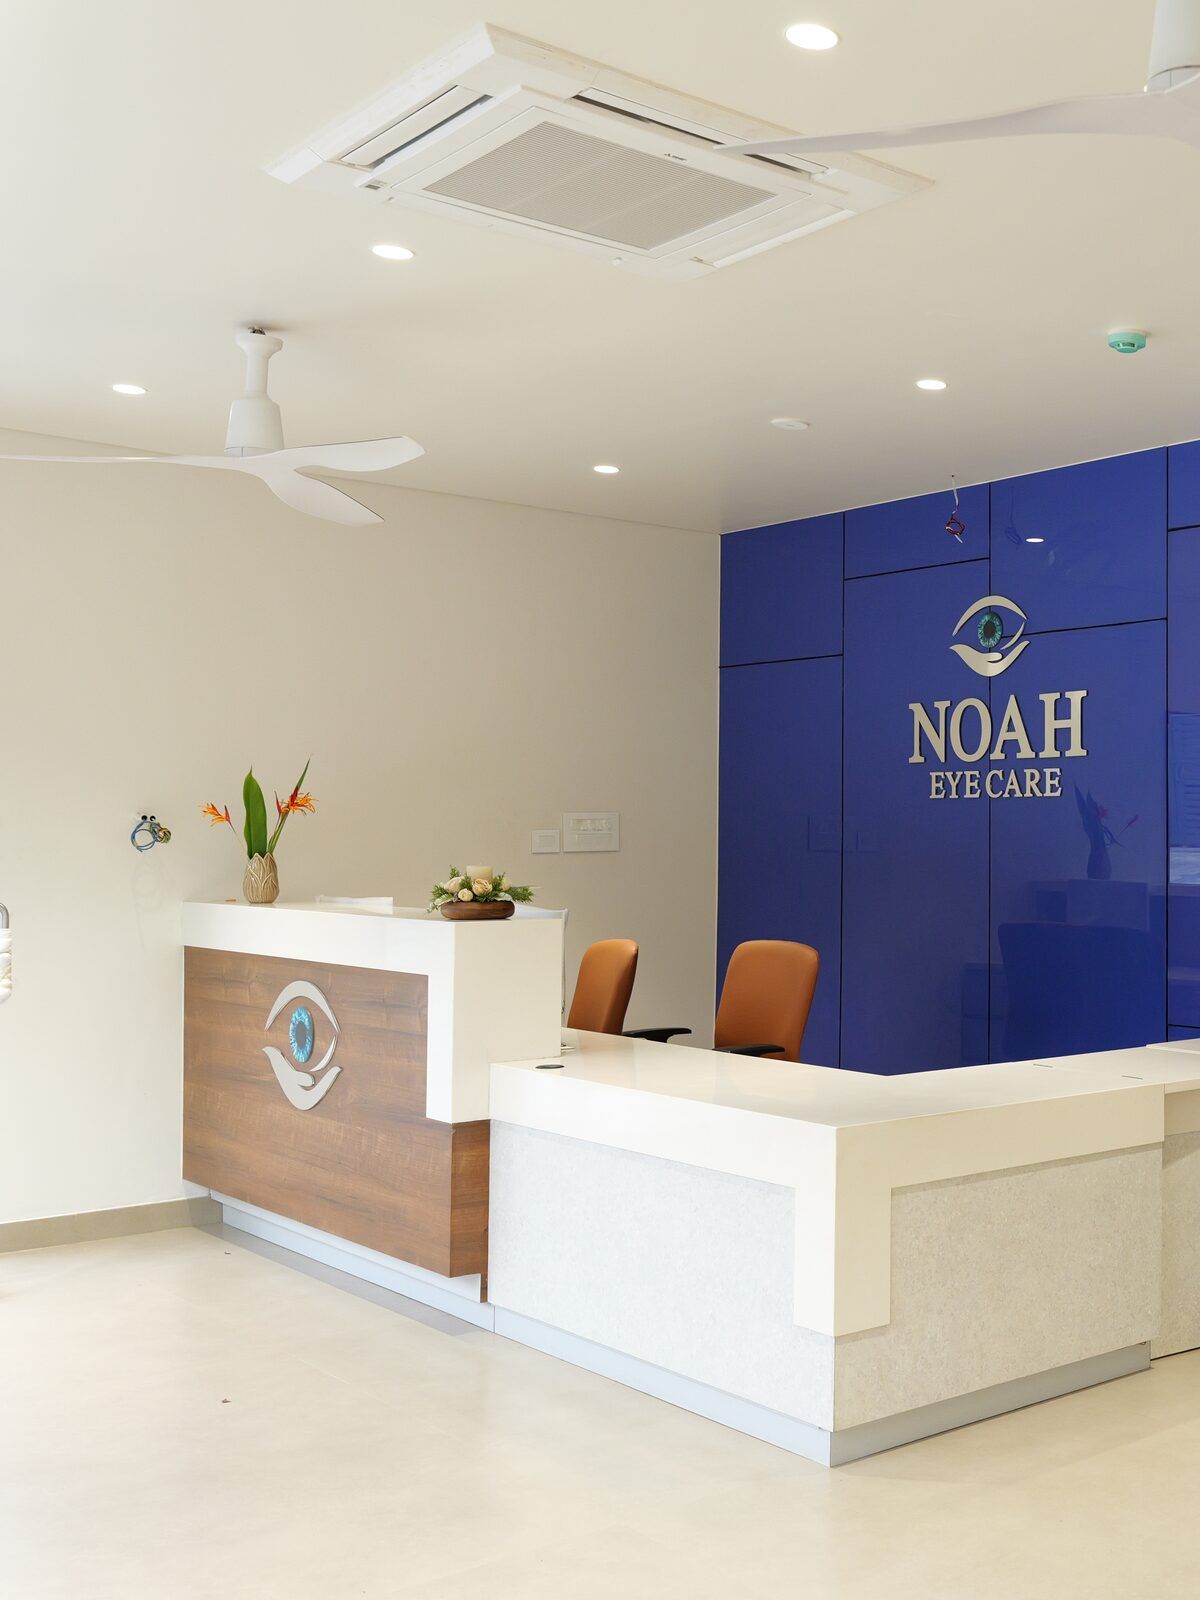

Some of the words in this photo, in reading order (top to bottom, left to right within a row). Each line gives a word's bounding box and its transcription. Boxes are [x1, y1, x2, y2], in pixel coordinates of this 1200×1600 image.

[908, 689, 1088, 764] NOAH
[929, 770, 981, 799] EYE
[985, 767, 1063, 799] CARE
